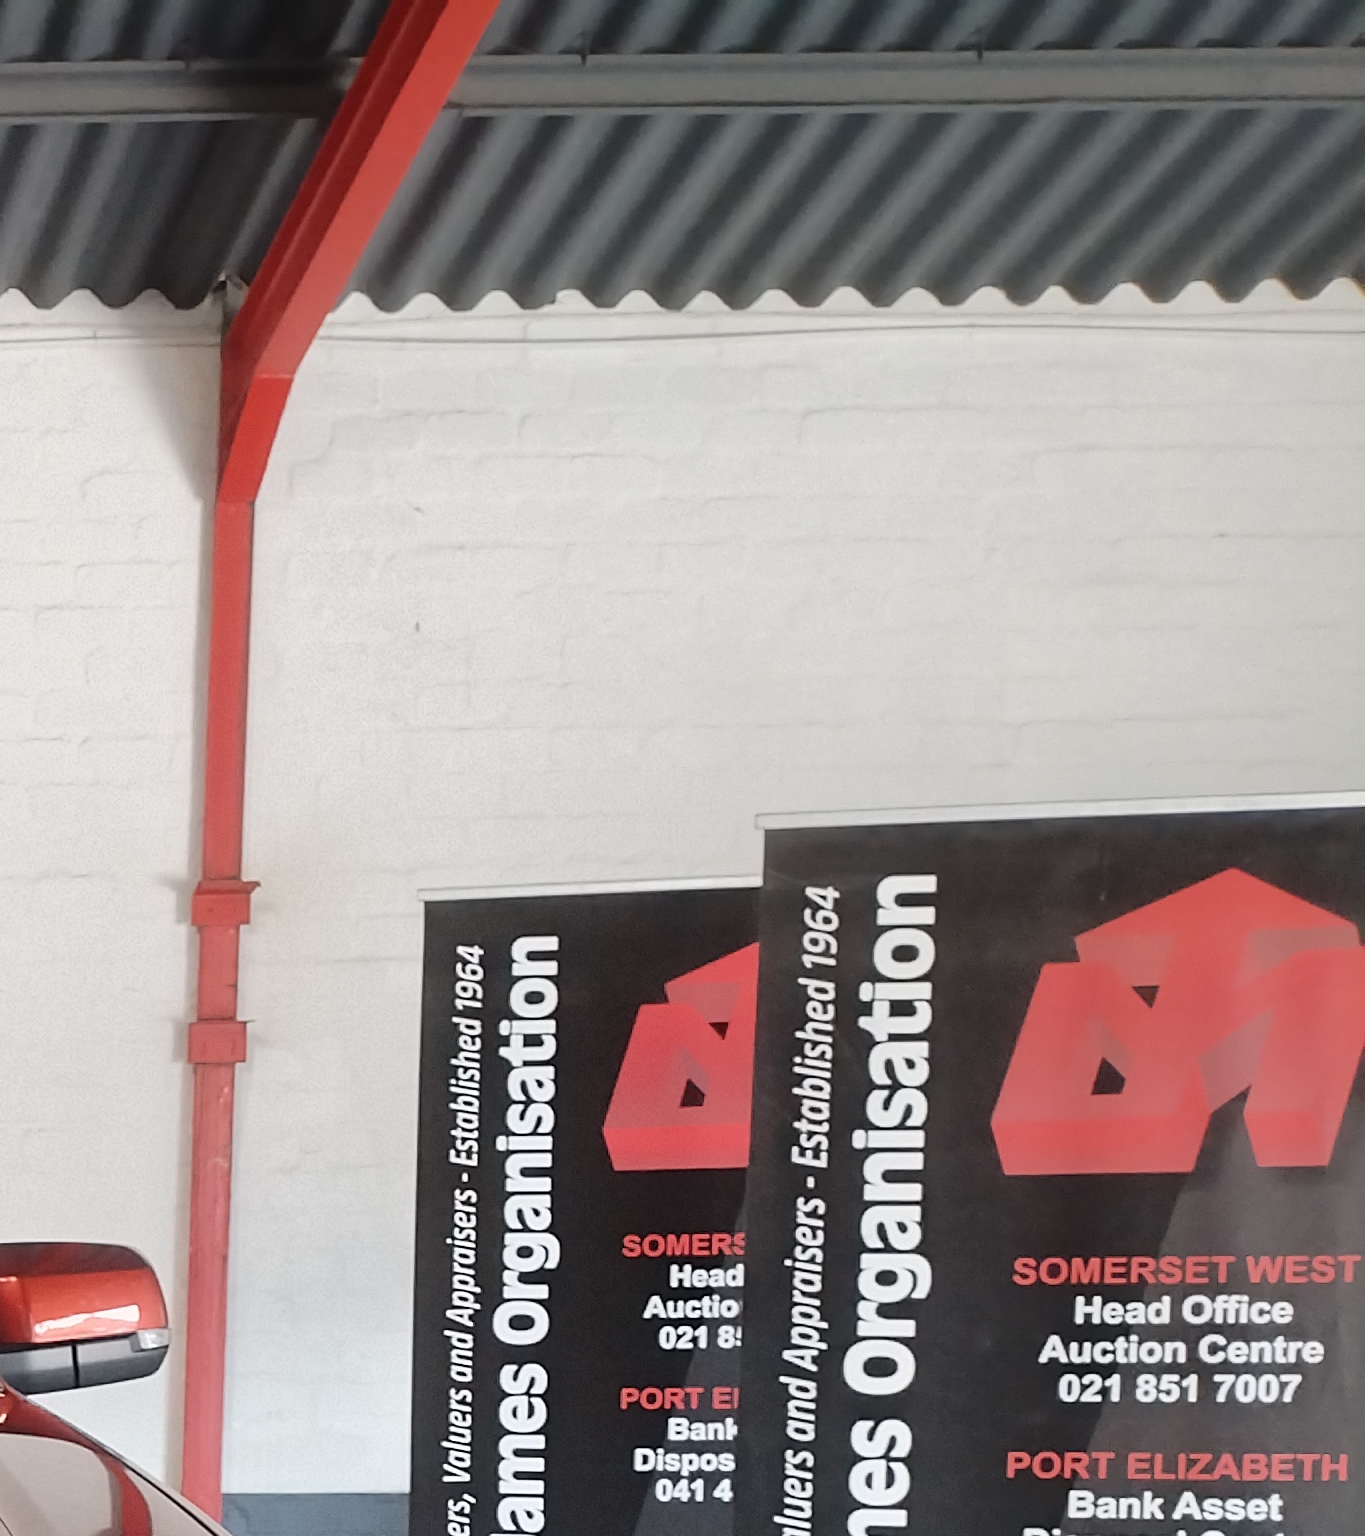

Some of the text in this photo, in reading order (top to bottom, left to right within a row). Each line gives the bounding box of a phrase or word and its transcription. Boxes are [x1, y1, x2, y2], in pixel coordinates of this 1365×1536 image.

[802, 886, 840, 966] 1964
[455, 945, 484, 1010] 1964
[449, 1016, 482, 1166] Established
[791, 978, 836, 1168] Established
[492, 935, 560, 1345] Organisation
[842, 873, 938, 1396] Organisation
[446, 1189, 481, 1327] Appraisers
[669, 1263, 745, 1288] Head
[782, 1196, 829, 1371] Appraisers
[1012, 1254, 1362, 1286] SOMERSET WEST
[1074, 1294, 1295, 1325] Head Office
[443, 1330, 473, 1382] and
[658, 1325, 708, 1350] 021
[1037, 1333, 1325, 1364] Auction Centre
[620, 1387, 705, 1410] PORT
[779, 1376, 817, 1441] and
[1058, 1373, 1303, 1404] 021 851 7007
[441, 1388, 472, 1482] Valuers
[655, 1478, 705, 1502] 041
[1006, 1450, 1349, 1482] PORT ELIZABETH
[1067, 1489, 1284, 1522] Bank Asset
